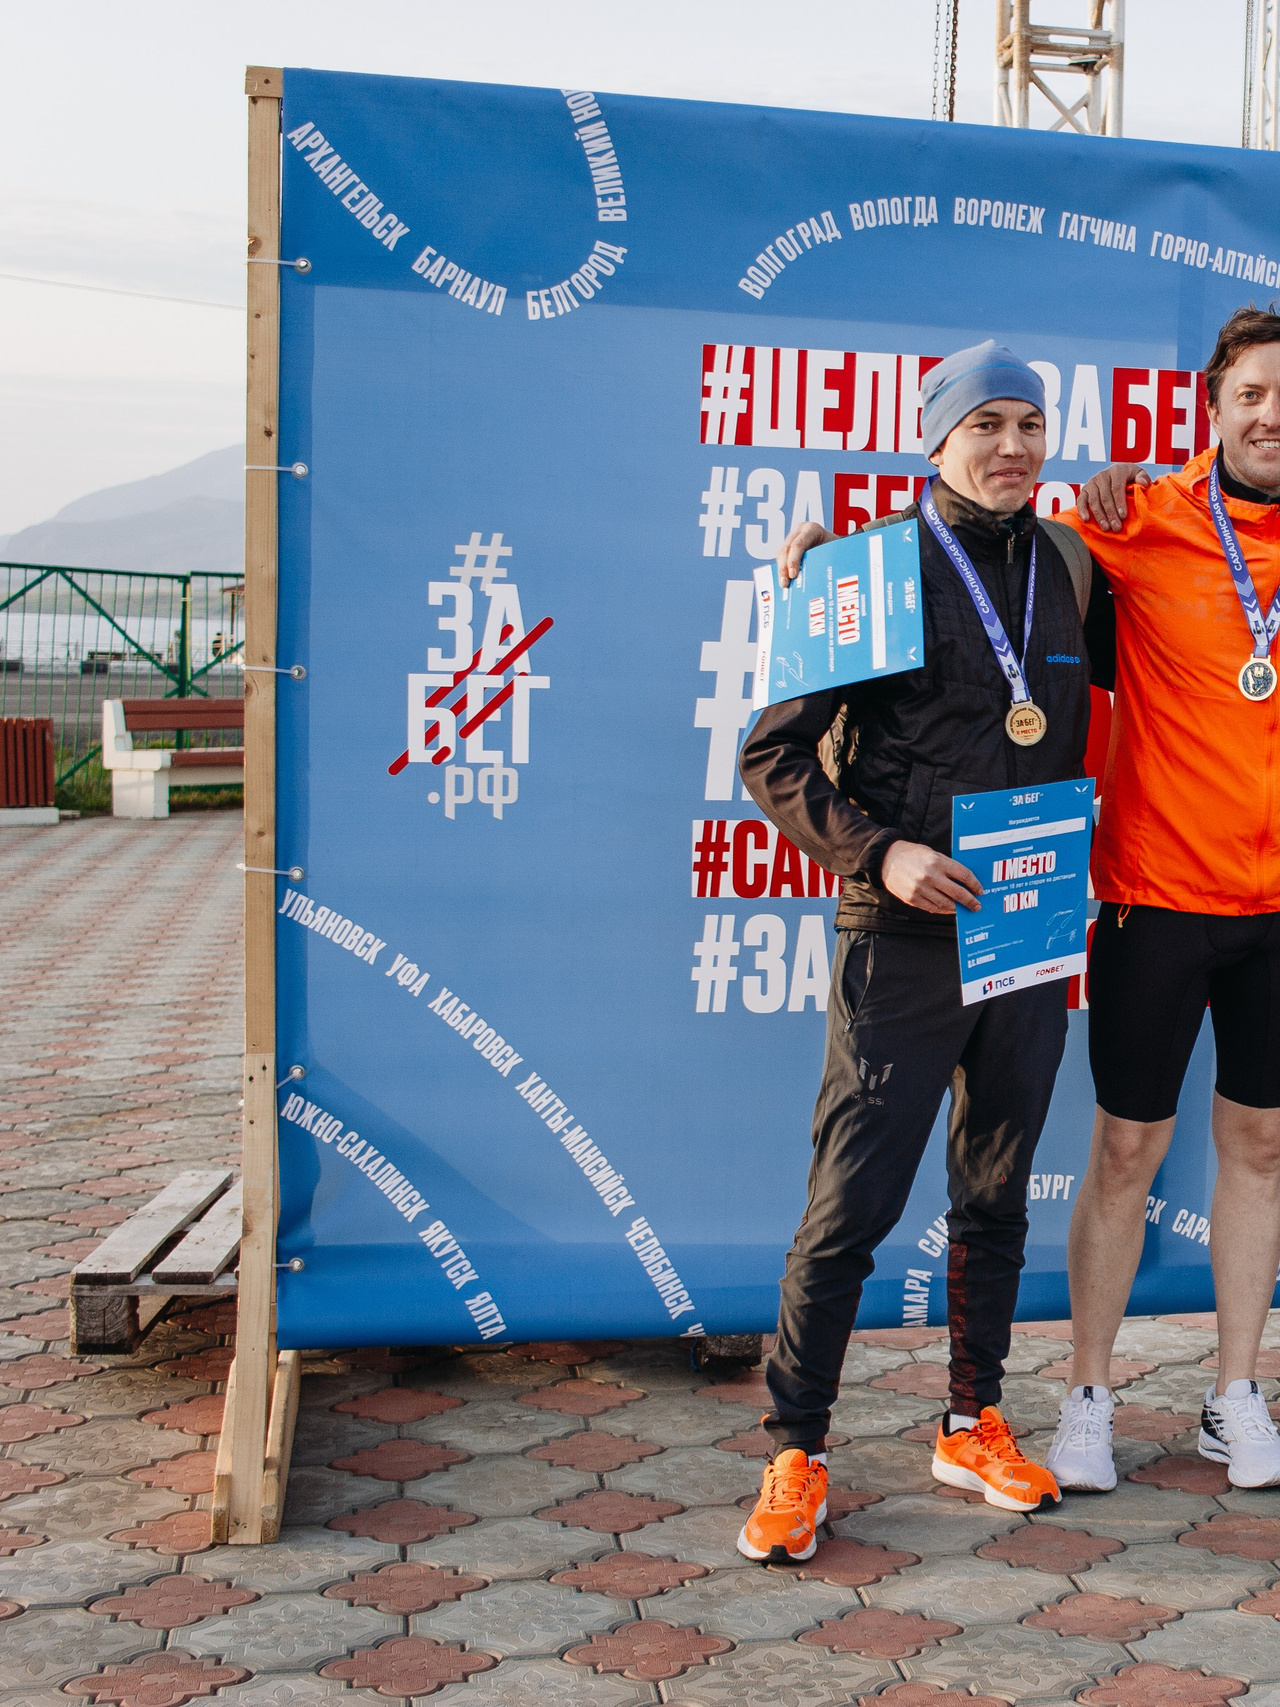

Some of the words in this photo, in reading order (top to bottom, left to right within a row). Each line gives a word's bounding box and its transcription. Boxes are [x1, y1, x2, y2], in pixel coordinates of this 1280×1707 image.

[560, 88, 602, 124] НО
[287, 121, 410, 251] АРХАНГЕЛЬСК
[574, 120, 627, 221] ВЕЛИКИЙ
[412, 245, 507, 316] БАРНАУЛ
[527, 239, 628, 320] БЕЛГОРОД
[738, 210, 842, 300] ВОЛГОГРАД
[849, 196, 938, 231] ВОЛОГДА
[954, 197, 1046, 234] ВОРОНЕЖ
[1059, 211, 1137, 253] ГАТЧИНА
[927, 503, 953, 544] ОБЛАСТЬ
[1213, 503, 1242, 571] САХАЛИНСКАЯ
[809, 597, 825, 613] 10
[949, 544, 989, 614] САХАЛИНСКАЯ
[427, 581, 532, 673] ЗА
[809, 616, 826, 637] КМ
[837, 586, 860, 646] МЕСТО
[408, 673, 551, 764] БЕГ
[1005, 850, 1056, 881] МЕСТО
[1004, 893, 1018, 913] 10
[1020, 889, 1038, 910] КМ
[995, 976, 1015, 989] ПСБ
[1035, 964, 1065, 977] FONBET
[278, 888, 387, 966] УЛЬЯНОВСК
[386, 953, 431, 997] УФА
[428, 987, 524, 1077] ХАБАРОВСК
[515, 1071, 636, 1217] ХАНТЫ-МАНСИЙСК
[624, 1216, 695, 1320] ЧЕЛЯБИНСК
[280, 1092, 430, 1223] ЮЖНО-САХАЛИНСК
[418, 1220, 480, 1290] ЯКУТСК
[465, 1291, 508, 1340] ЯЛТА
[1171, 1209, 1211, 1246] САРА
